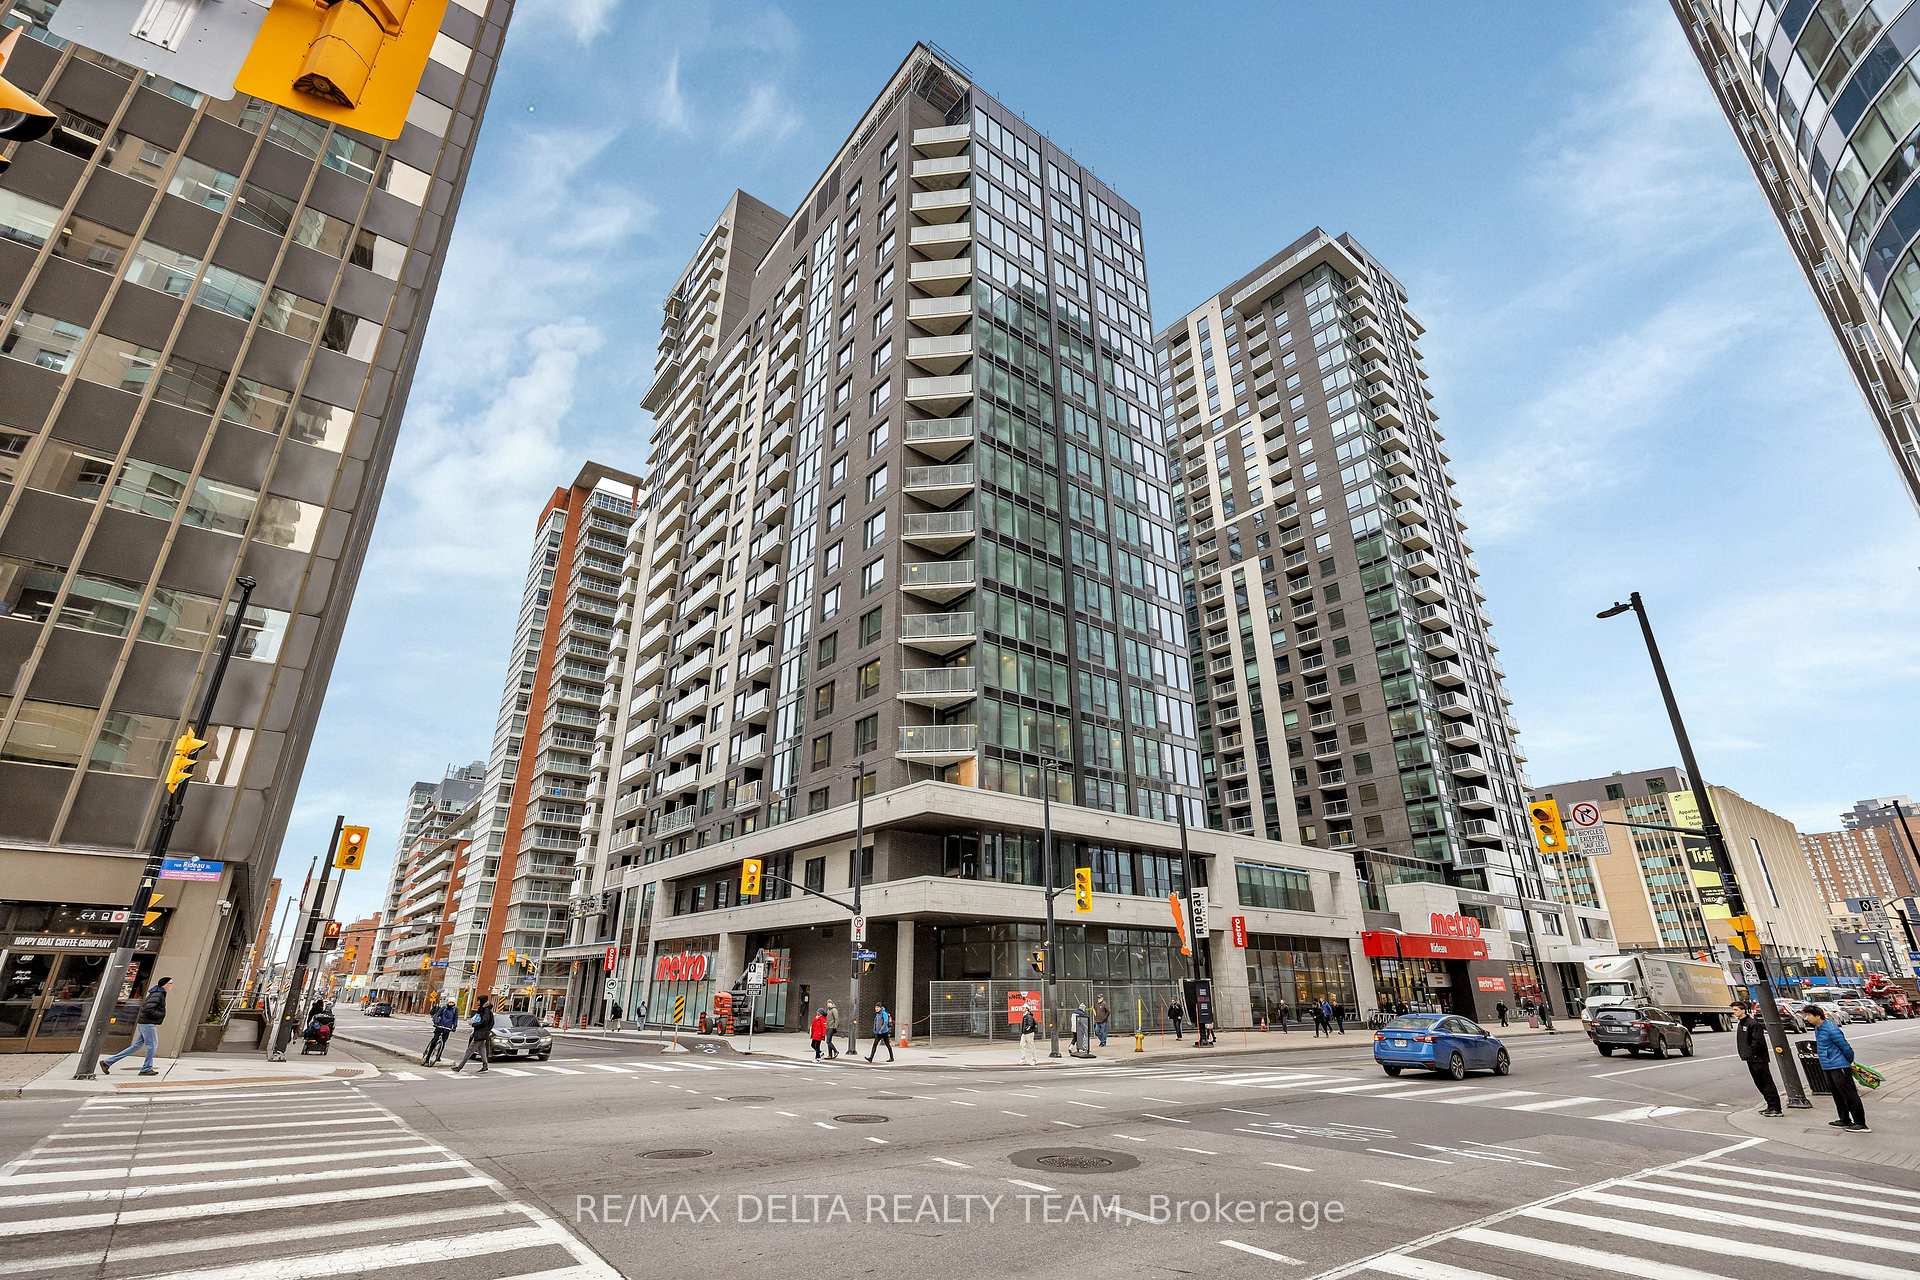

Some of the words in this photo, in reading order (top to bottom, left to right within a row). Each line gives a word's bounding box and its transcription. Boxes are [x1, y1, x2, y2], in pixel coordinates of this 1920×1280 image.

[1234, 918, 1243, 946] metro
[1429, 911, 1481, 938] metro
[14, 936, 37, 946] HAPPY
[54, 938, 79, 947] COFFEE
[78, 938, 113, 948] COMPANY
[607, 948, 615, 970] metro
[655, 950, 707, 982] metro
